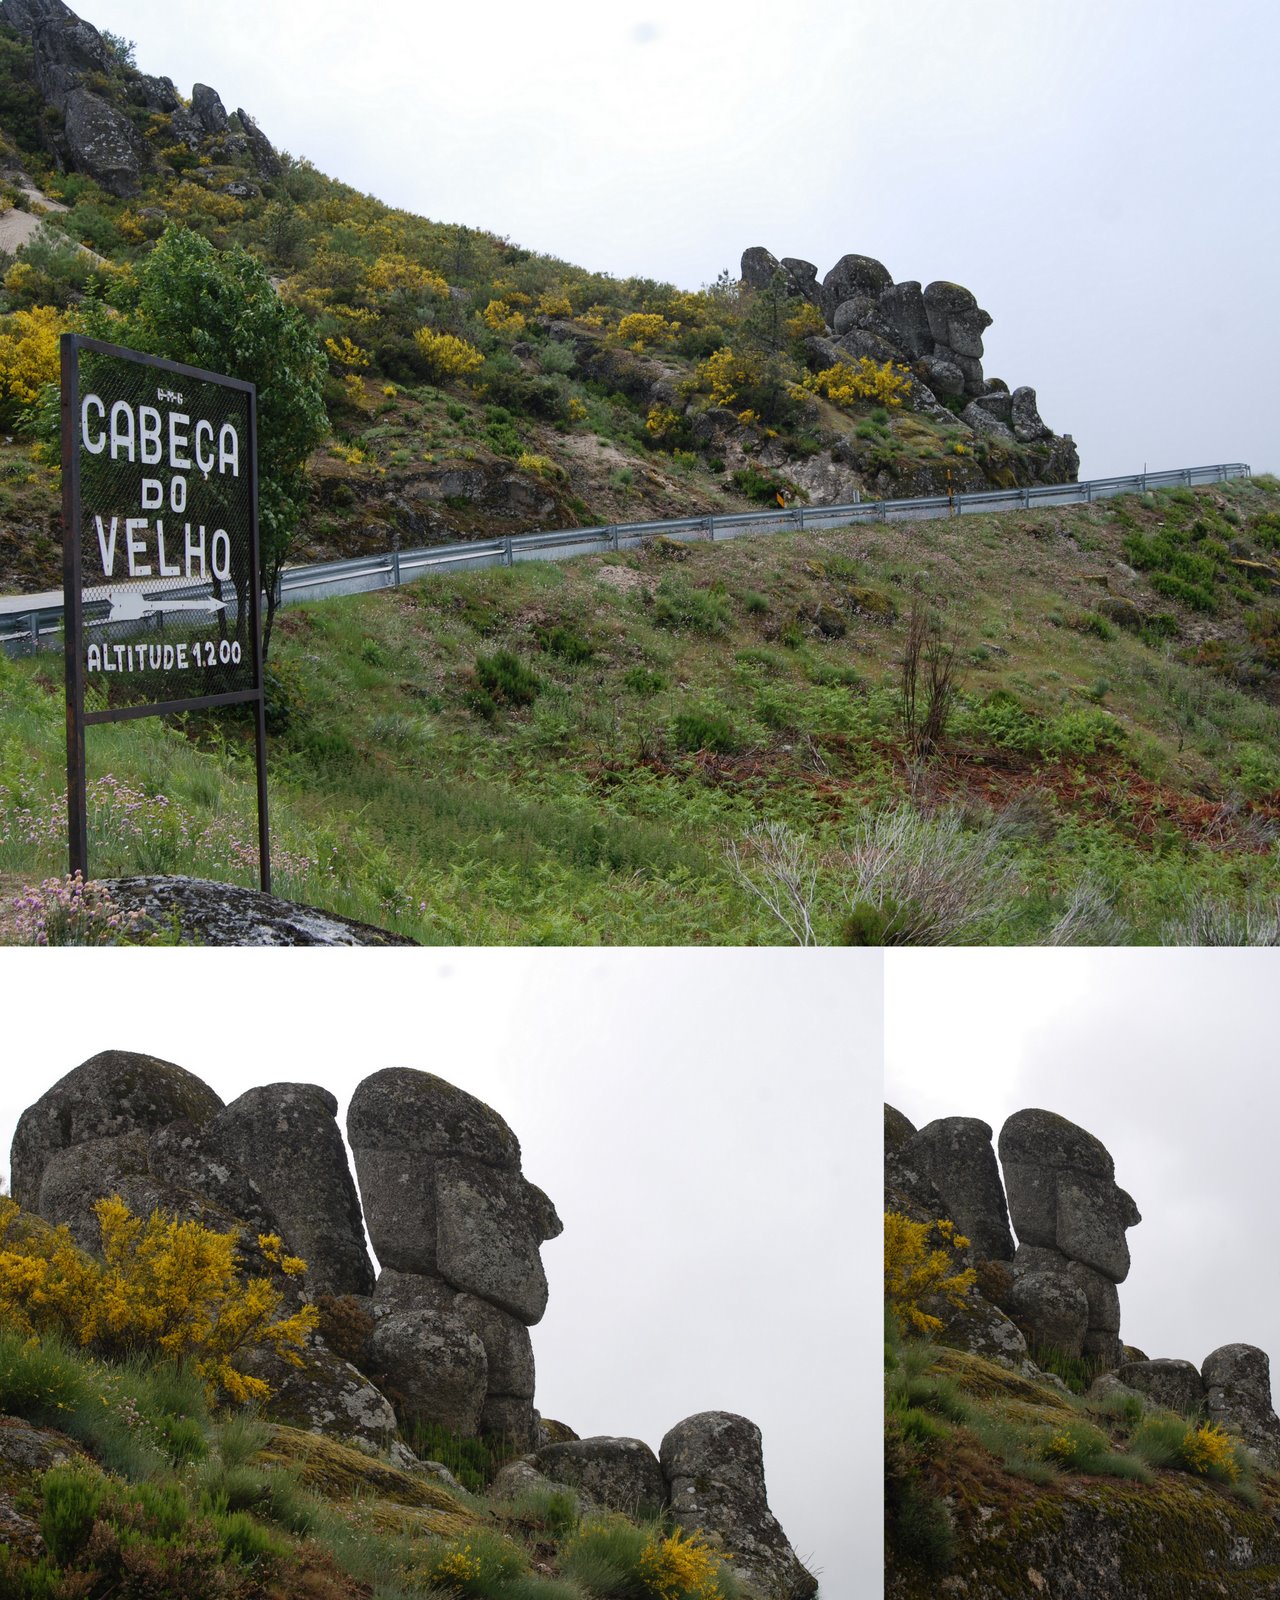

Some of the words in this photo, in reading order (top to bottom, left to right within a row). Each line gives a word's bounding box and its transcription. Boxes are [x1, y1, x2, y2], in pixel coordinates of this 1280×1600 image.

[81, 394, 239, 480] CABEÇA
[141, 475, 187, 513] DO
[95, 515, 231, 580] VELHO
[87, 643, 189, 672] ALTITUDE
